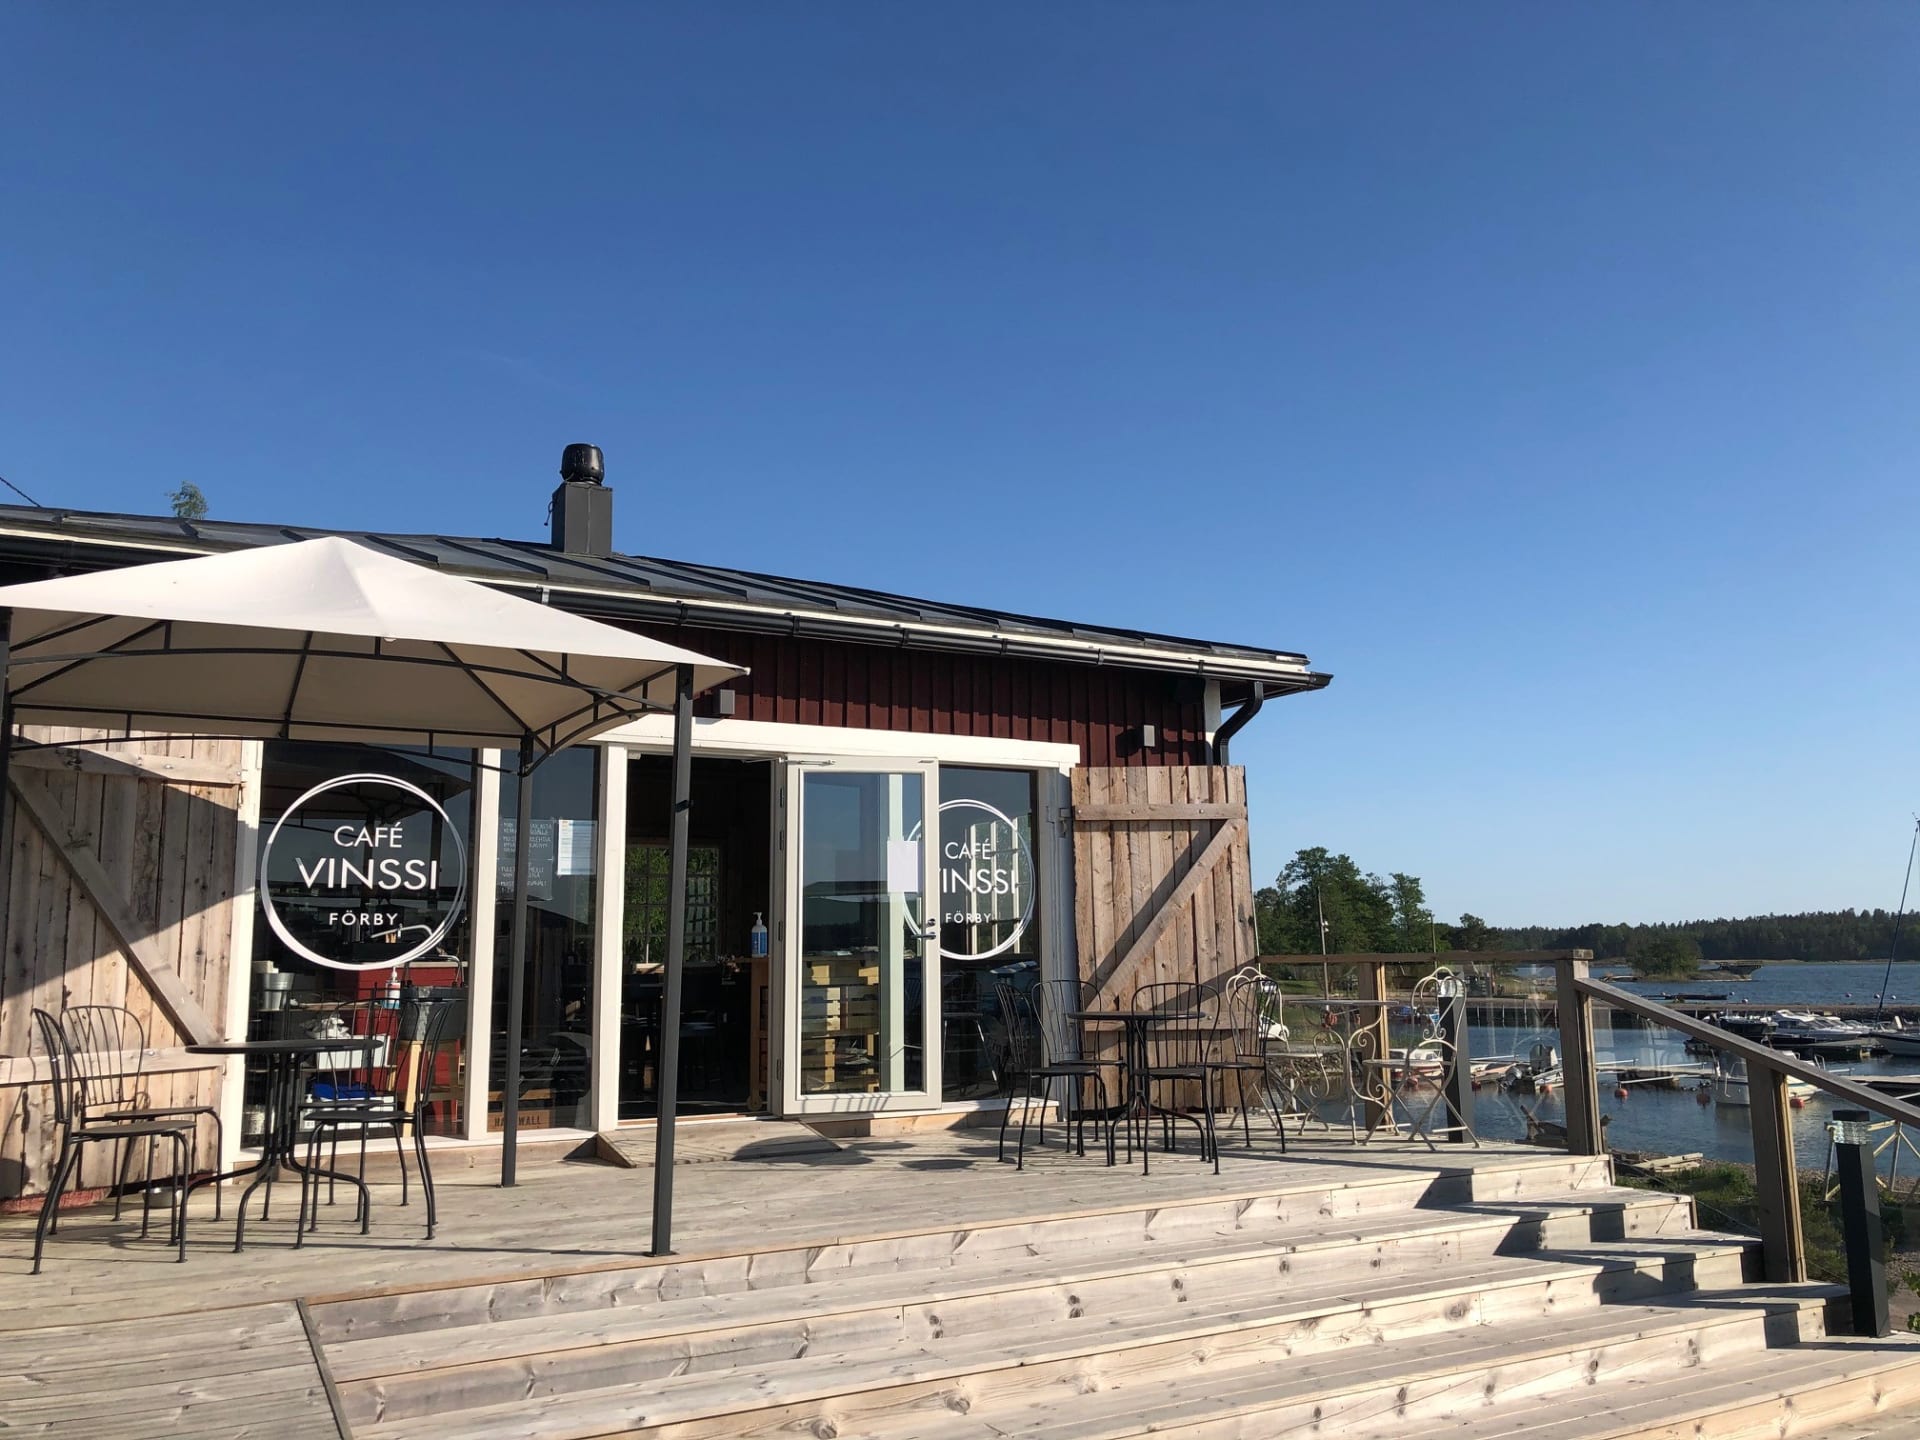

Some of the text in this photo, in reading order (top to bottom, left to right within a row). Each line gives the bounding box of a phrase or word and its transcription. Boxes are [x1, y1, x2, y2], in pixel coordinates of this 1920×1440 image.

[333, 822, 403, 848] CAFÉ
[945, 838, 991, 860] CAFÉ
[295, 857, 438, 891] VINSSI
[938, 868, 1015, 895] INSSI
[329, 909, 399, 926] FÖRBY
[945, 910, 992, 924] FÖRBY
[494, 1115, 542, 1127] HAWALL
